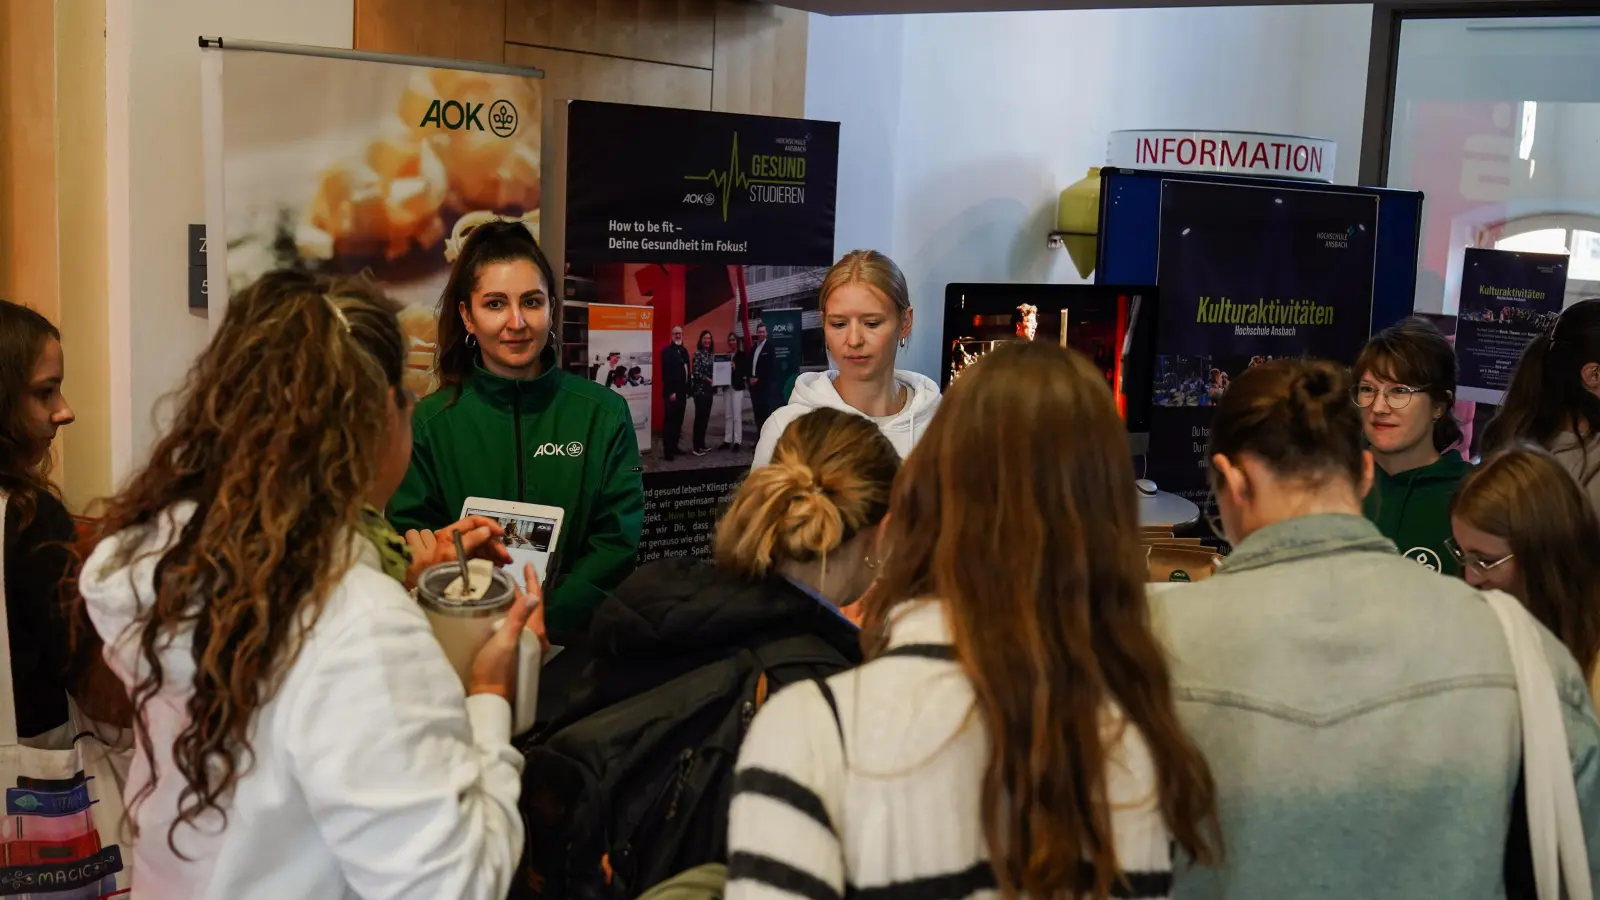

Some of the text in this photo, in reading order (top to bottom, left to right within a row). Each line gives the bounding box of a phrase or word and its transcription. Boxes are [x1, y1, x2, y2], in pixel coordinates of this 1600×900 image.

[420, 99, 485, 131] AOK
[1135, 137, 1323, 173] INFORMATION
[752, 155, 806, 179] GESUND
[682, 193, 704, 205] AOK
[750, 185, 805, 204] STUDIEREN
[609, 219, 632, 232] How
[634, 221, 645, 232] to
[647, 220, 660, 233] be
[661, 222, 674, 233] fit
[608, 237, 747, 253] Deine Gesundheit im Fokus!
[1480, 284, 1546, 300] Kulturaktivitäten
[1196, 296, 1334, 326] Kulturaktivitäten
[1234, 325, 1296, 337] Hochschule Ansbach
[533, 442, 566, 458] AOK
[643, 488, 653, 497] nd
[654, 486, 681, 499] gesund
[682, 483, 706, 495] leben?
[706, 482, 728, 493] Klingt
[644, 494, 736, 510] die wir gemeinsam mei
[643, 514, 662, 524] ojekt
[656, 525, 668, 534] wir
[692, 522, 709, 530] dass
[648, 538, 679, 549] genauso
[680, 536, 693, 544] wie
[694, 534, 705, 542] die
[643, 551, 661, 563] jede
[664, 549, 688, 559] Menge
[38, 863, 91, 886] MAGIC
